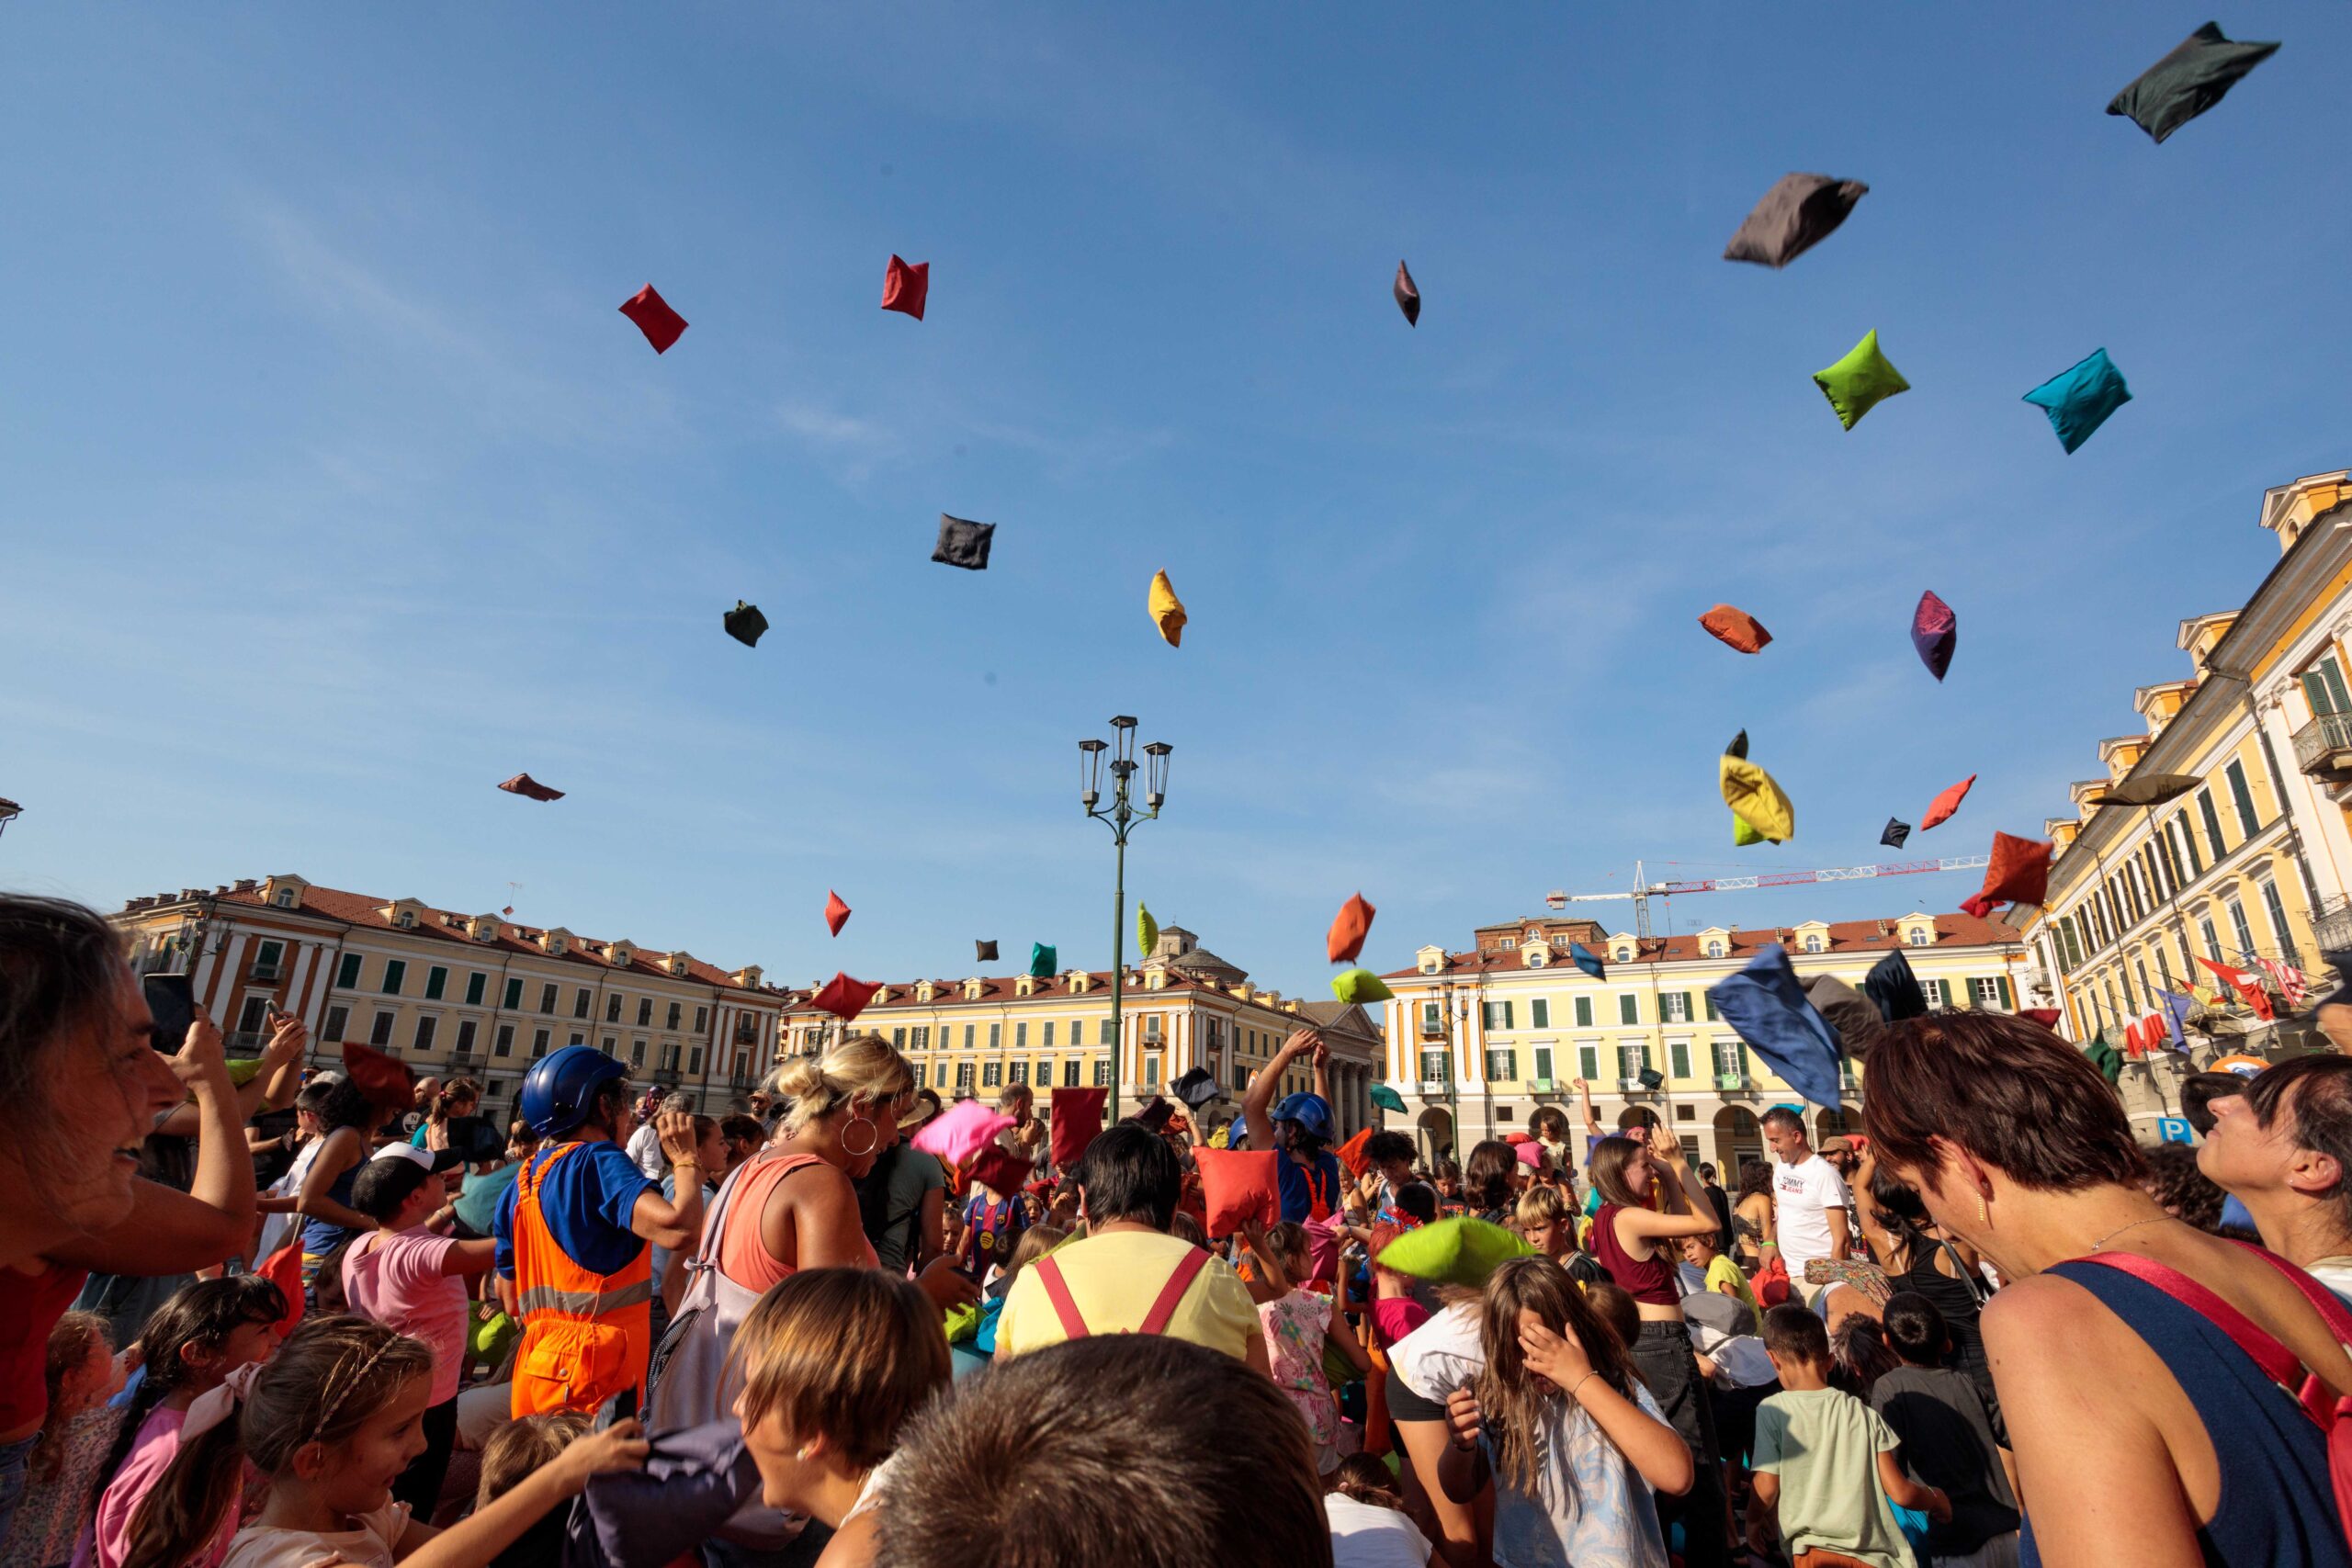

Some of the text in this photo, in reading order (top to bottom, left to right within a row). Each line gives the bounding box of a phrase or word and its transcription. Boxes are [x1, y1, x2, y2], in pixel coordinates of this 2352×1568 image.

[2164, 1120, 2184, 1141] P
[1782, 1176, 1804, 1189] TOMMY
[1786, 1186, 1804, 1195] JEANS
